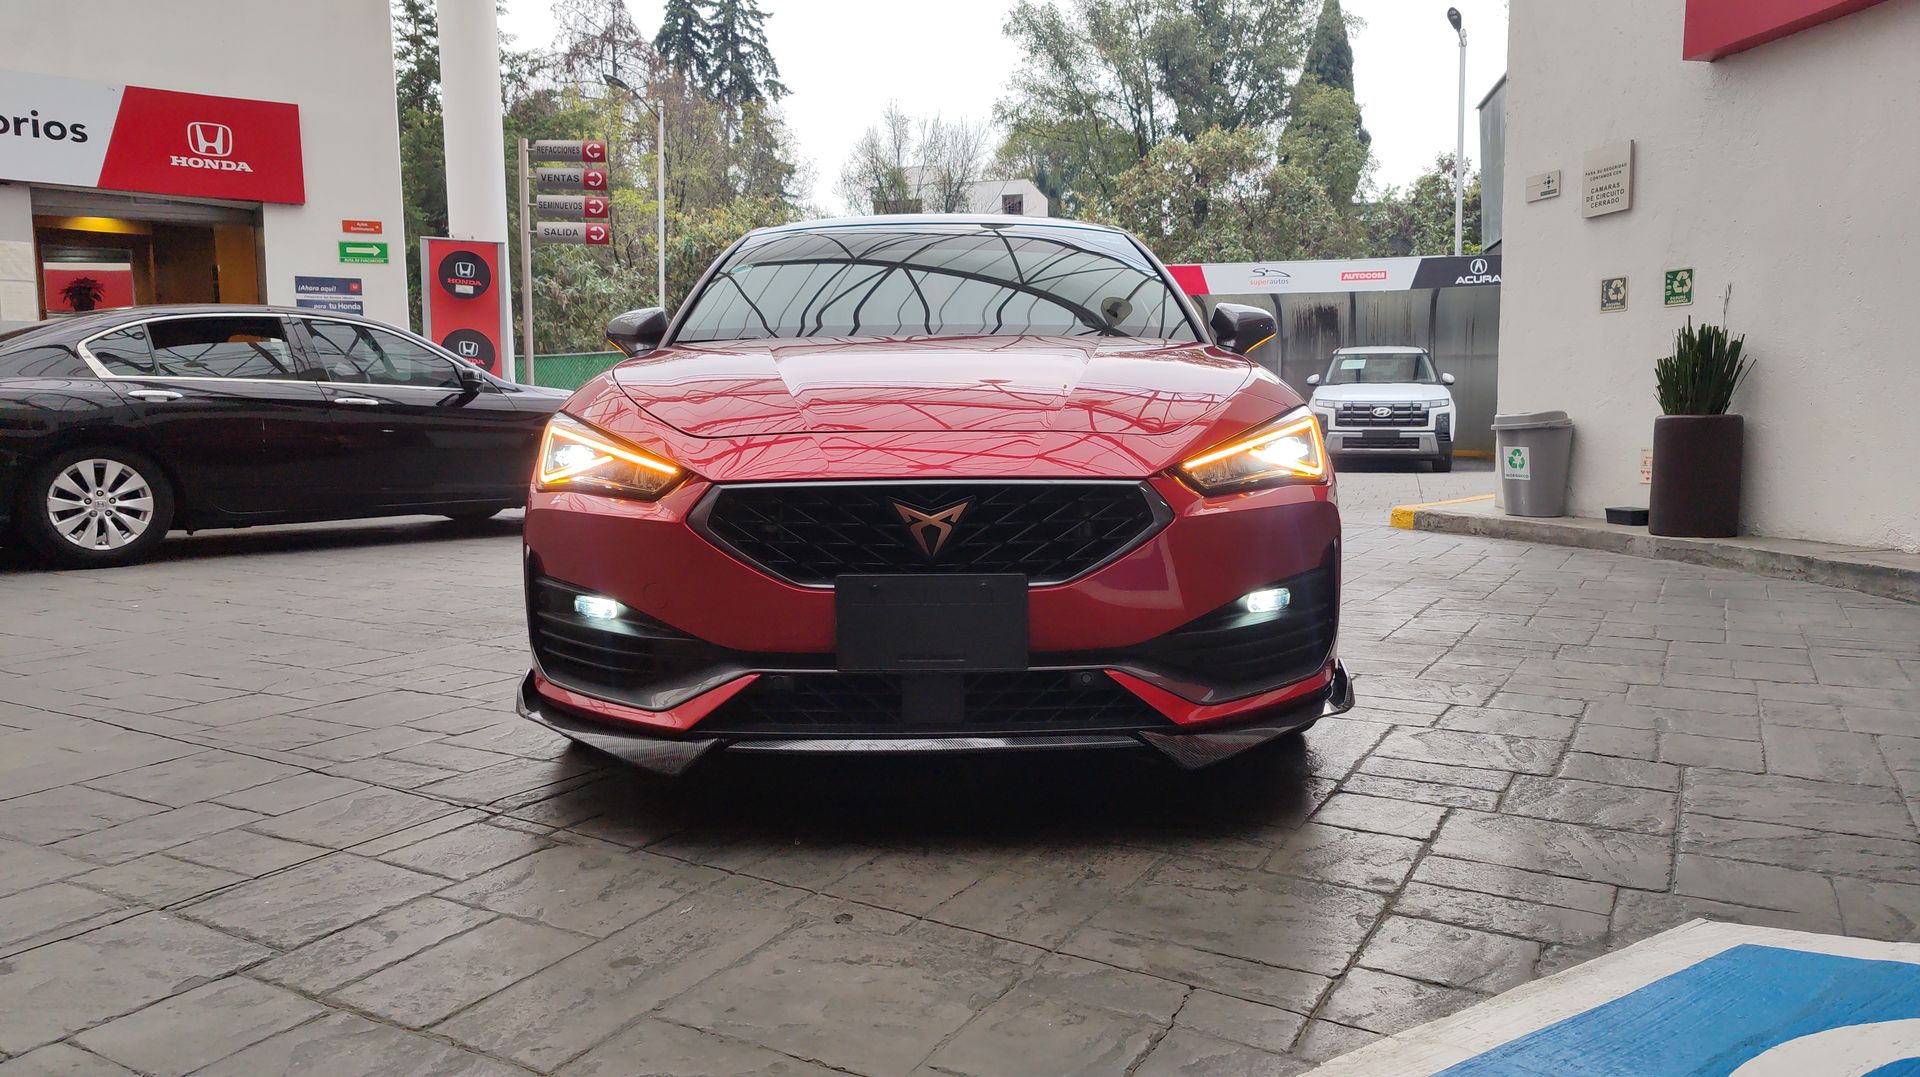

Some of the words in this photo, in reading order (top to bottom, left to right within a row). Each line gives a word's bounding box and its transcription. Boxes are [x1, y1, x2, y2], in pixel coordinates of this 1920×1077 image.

[536, 145, 580, 155] REFACCIONES
[169, 155, 254, 173] HONDA
[540, 173, 580, 183] VENTAS
[1596, 189, 1624, 200] CIRCUITO
[538, 201, 583, 210] SEMINUEVOS
[1590, 197, 1620, 208] CERRADO
[543, 227, 579, 237] SALIDA
[1343, 272, 1385, 280] AUTOCOM
[1455, 275, 1501, 285] ACURA
[447, 278, 482, 287] HONDA
[1249, 278, 1290, 287] superautos
